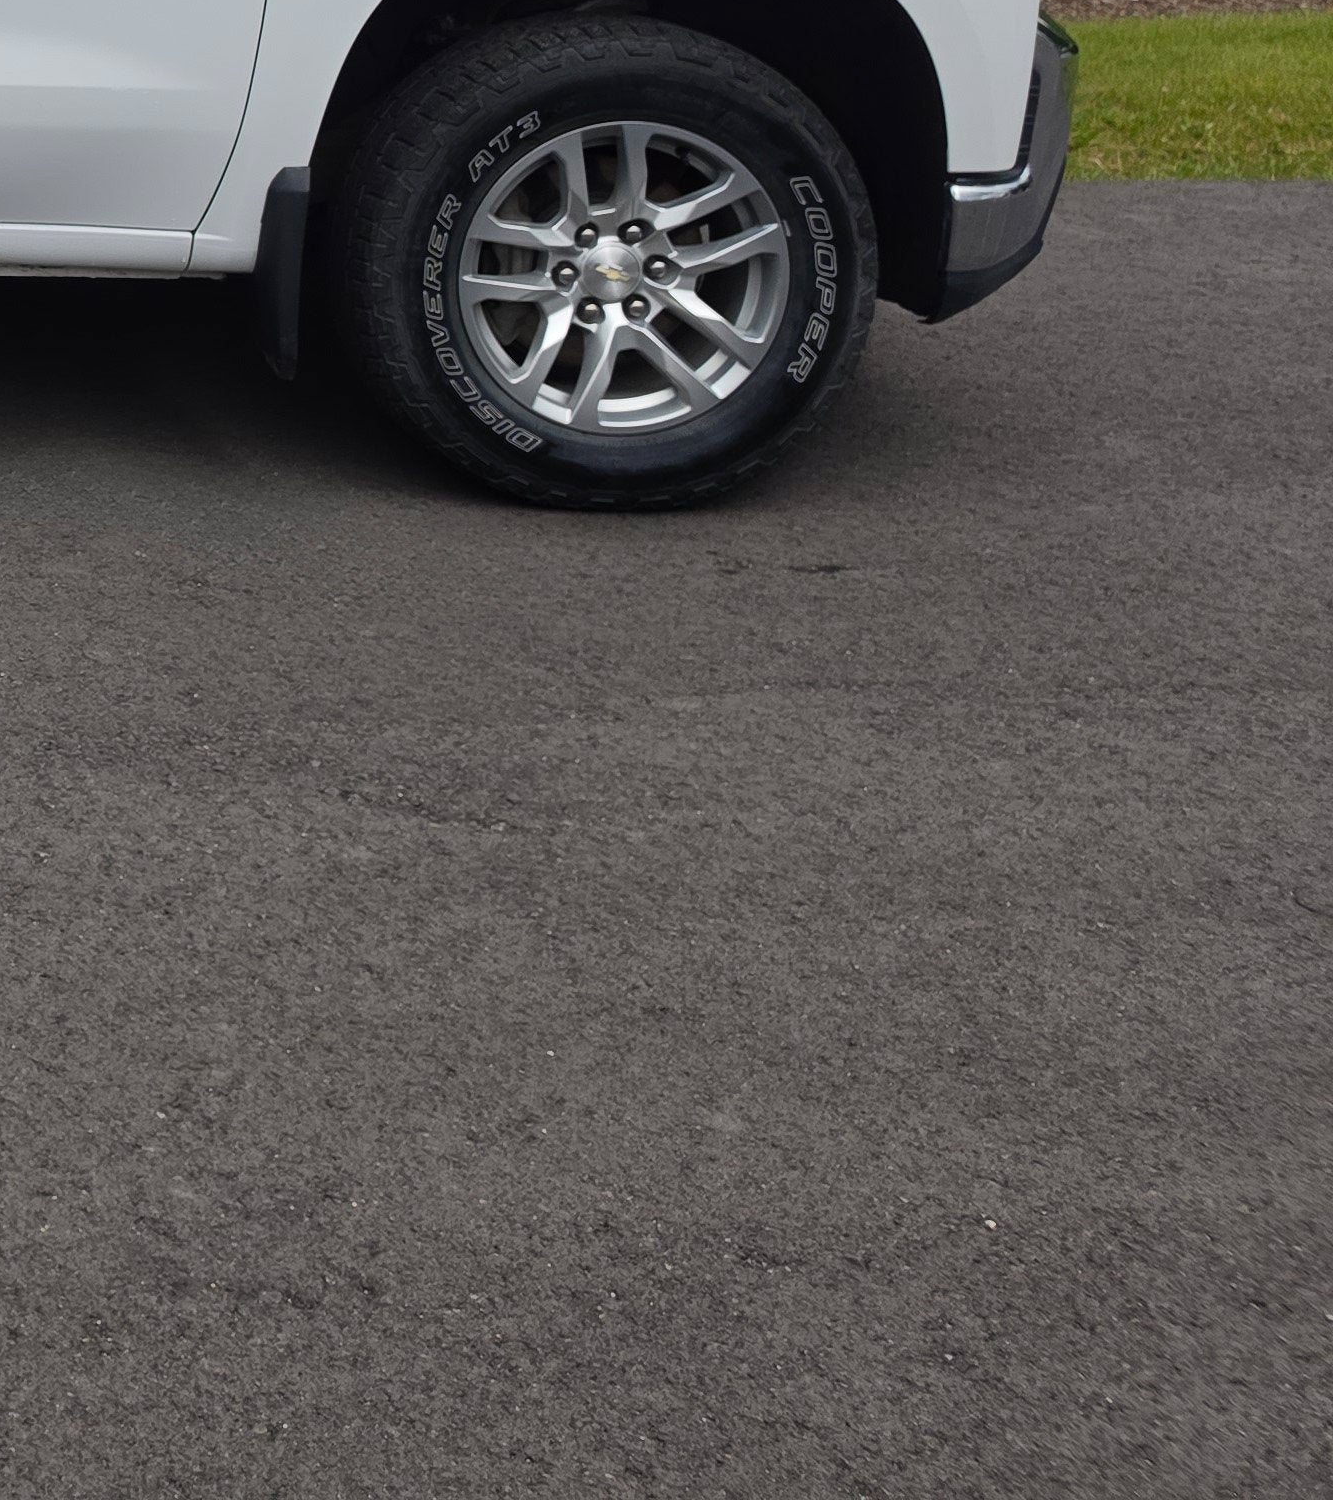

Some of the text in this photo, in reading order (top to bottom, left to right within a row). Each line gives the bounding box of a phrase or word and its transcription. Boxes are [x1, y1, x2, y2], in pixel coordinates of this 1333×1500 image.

[423, 111, 544, 453] DISCOVERER AT3
[786, 175, 838, 384] COOPER
